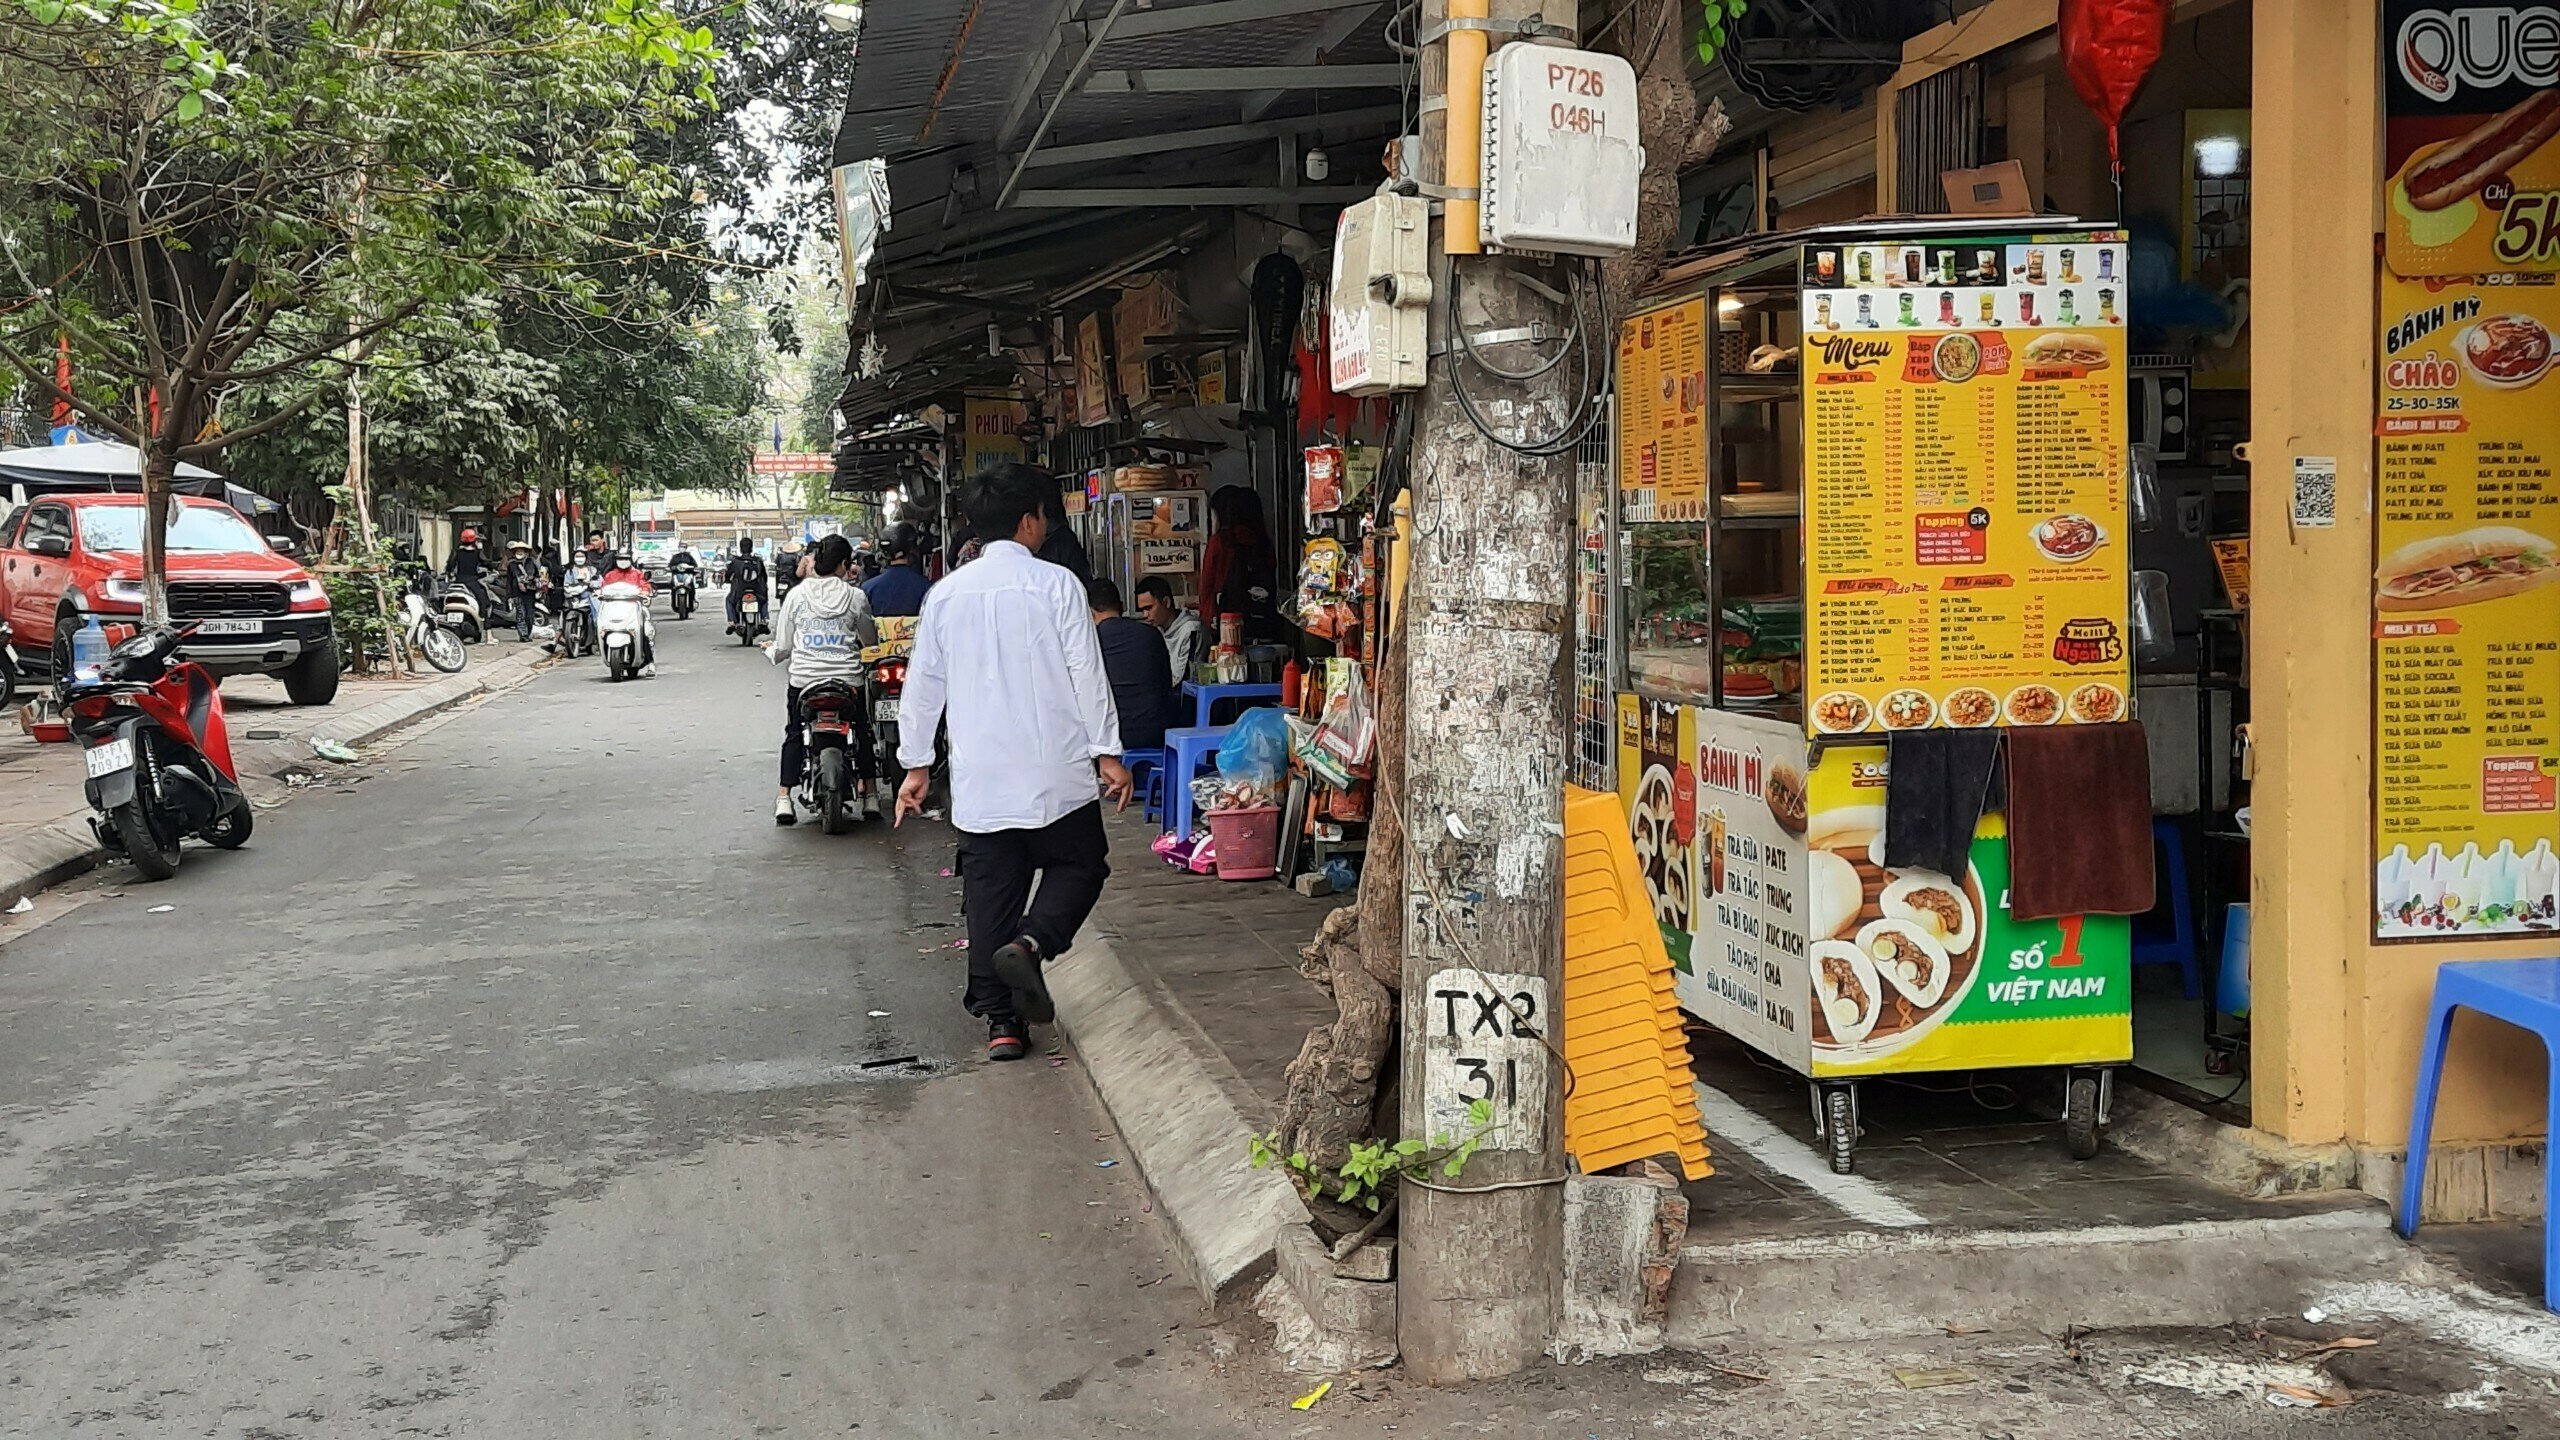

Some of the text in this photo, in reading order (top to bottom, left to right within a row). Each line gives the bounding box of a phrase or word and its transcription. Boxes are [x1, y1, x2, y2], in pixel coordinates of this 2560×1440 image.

[1547, 63, 1604, 98] P726
[1551, 103, 1606, 138] 046H
[2386, 311, 2445, 354] BÁNH
[1808, 335, 1893, 370] Menu
[2386, 353, 2459, 389] CHẢO
[2387, 396, 2460, 410] 25-30-35K
[975, 407, 999, 435] PHỞ
[1919, 516, 1965, 528] Topping
[2417, 623, 2437, 634] TEA
[1700, 736, 1762, 798] BÁNH MÌ
[2485, 760, 2535, 772] Topping
[1727, 833, 1759, 862] TRÀ SỮA
[1728, 867, 1759, 901] TRÀ TẮC
[1766, 883, 1792, 914] TRỨNG
[1718, 904, 1732, 926] TRÀ
[1732, 906, 1742, 931] BÍ
[1726, 940, 1742, 966] TÀO
[1765, 922, 1804, 958] XÚC XÍCH
[2008, 913, 2086, 971] SỐ 1
[1707, 967, 1720, 992] SỮA
[1737, 984, 1759, 1014] NÀNH
[1987, 975, 2106, 1007] VIỆT NAM
[1434, 989, 1544, 1040] TX2
[1779, 1004, 1794, 1033] XÍU
[1455, 1058, 1517, 1110] 31
